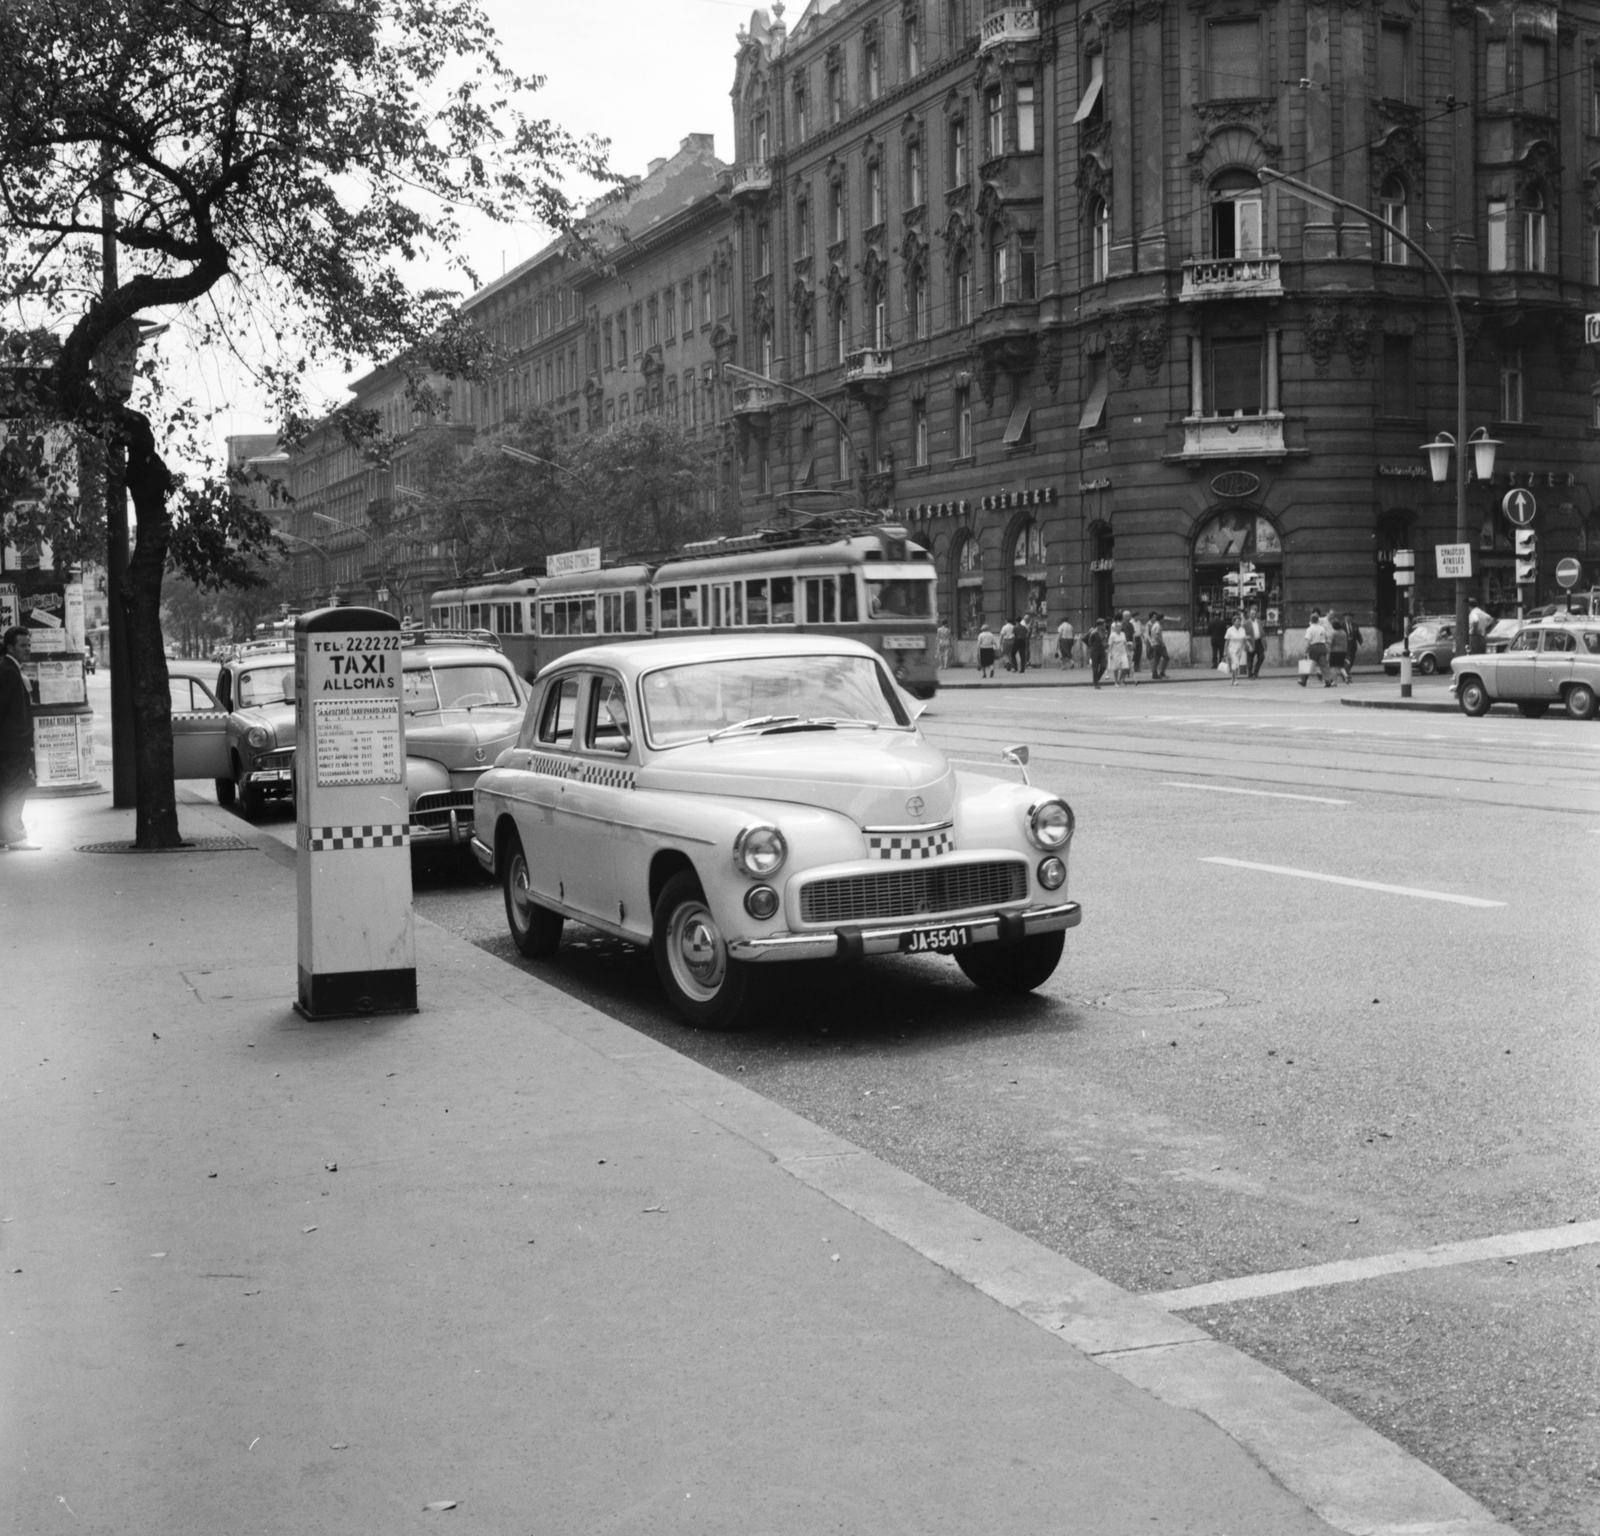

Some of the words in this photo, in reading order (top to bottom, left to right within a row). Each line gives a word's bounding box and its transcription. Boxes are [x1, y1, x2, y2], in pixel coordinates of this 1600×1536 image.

[981, 487, 1051, 511] CSEMEGE
[314, 641, 344, 652] TEL:
[329, 654, 385, 675] TAXI
[323, 674, 395, 690] ÁLLOMÁS
